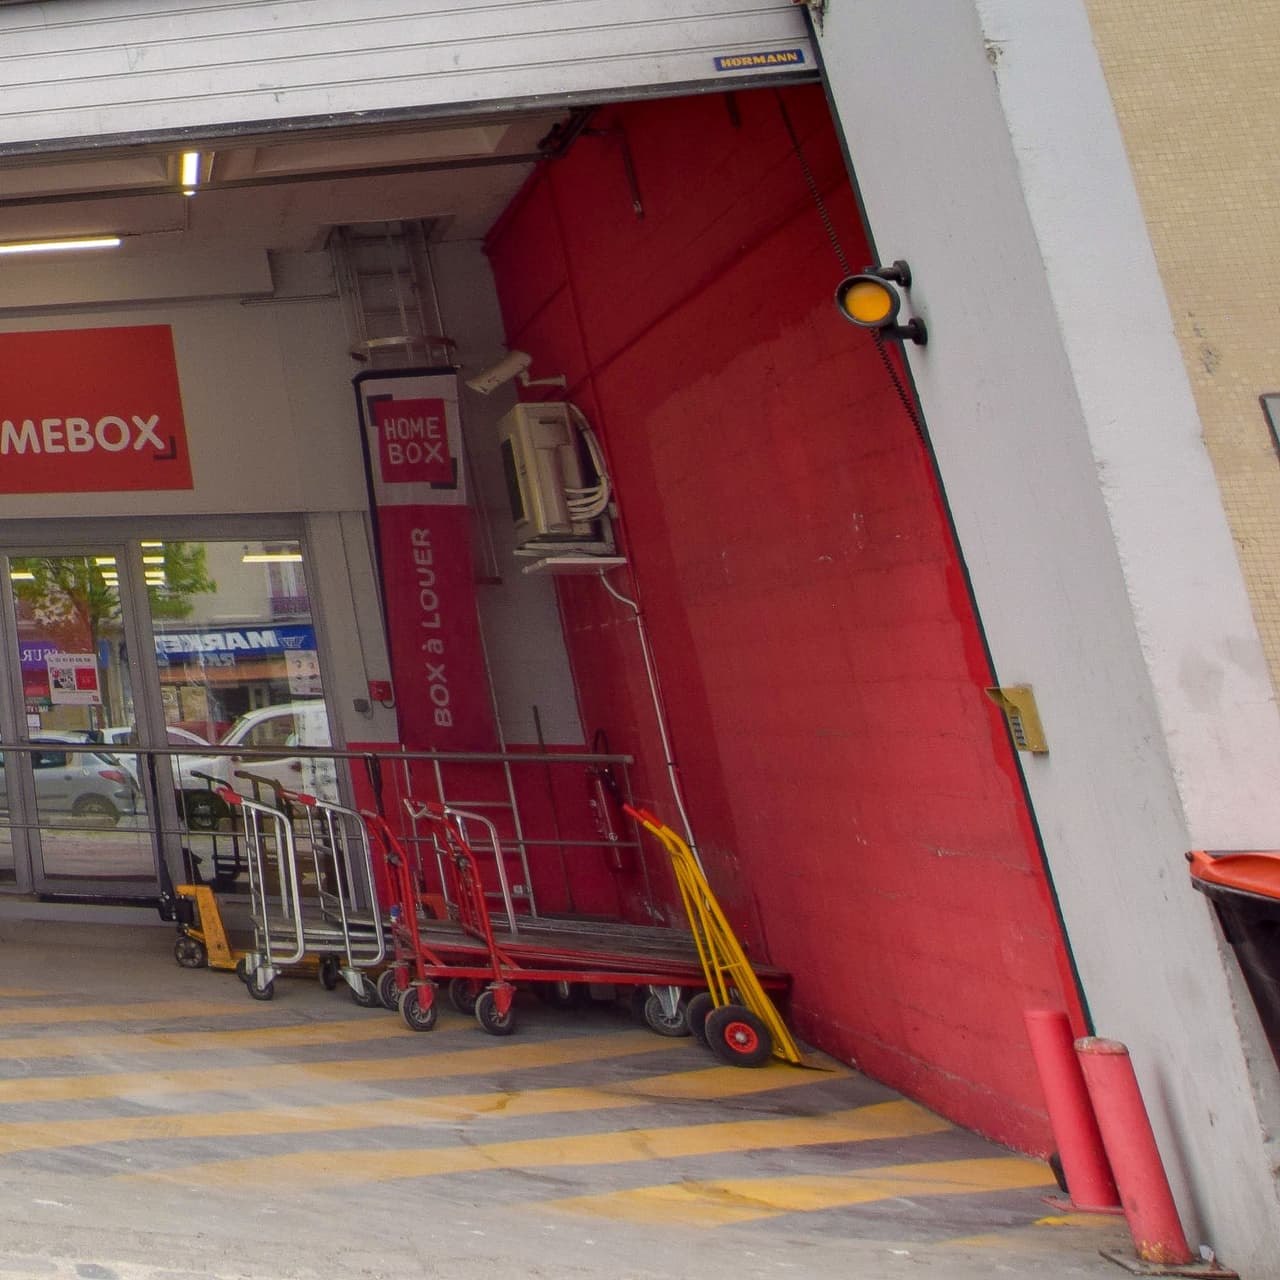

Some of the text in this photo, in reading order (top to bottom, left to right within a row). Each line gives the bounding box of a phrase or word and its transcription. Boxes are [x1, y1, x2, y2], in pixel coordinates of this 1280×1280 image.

[383, 417, 440, 441] HOME
[389, 441, 445, 465] BOX
[411, 527, 453, 728] BOX à LOUER
